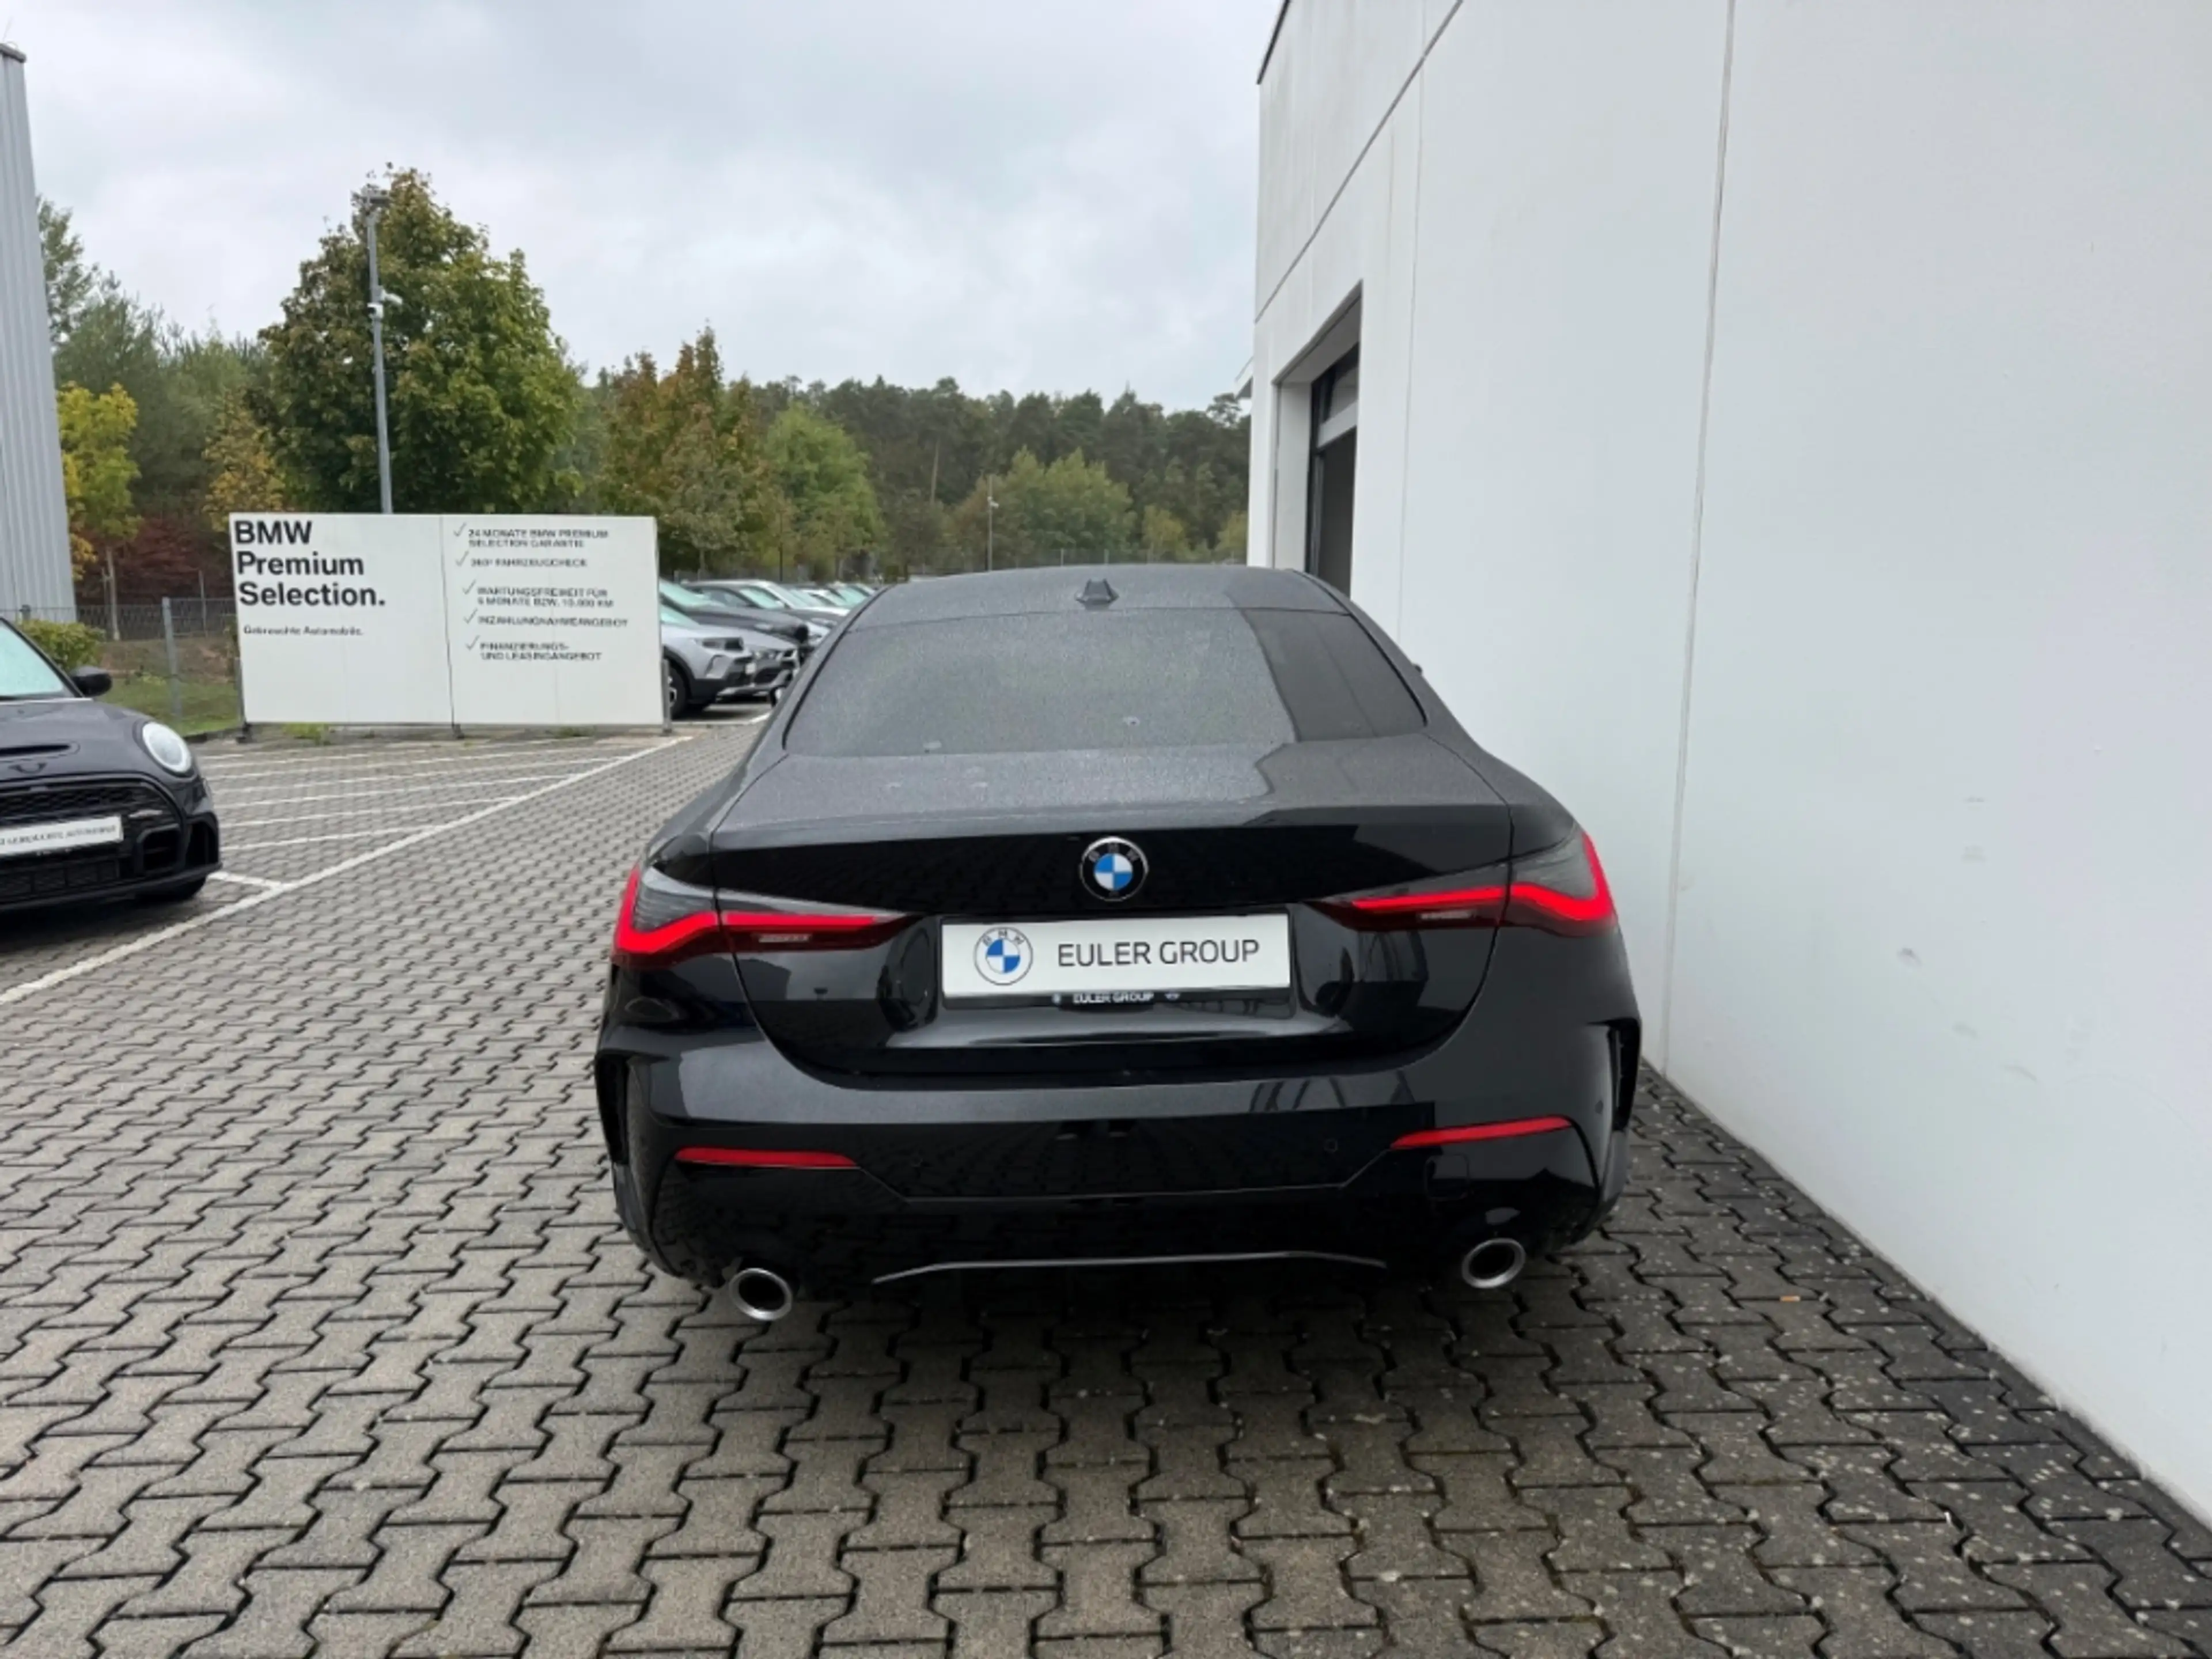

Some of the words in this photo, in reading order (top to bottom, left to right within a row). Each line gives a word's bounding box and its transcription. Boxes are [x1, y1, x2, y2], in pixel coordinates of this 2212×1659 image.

[234, 520, 312, 544] BMW
[237, 551, 364, 575] Premium
[239, 581, 385, 606] Selection.
[1058, 941, 1152, 967] EULER
[1159, 939, 1260, 964] GROUP
[1073, 993, 1111, 1004] EULER
[1112, 991, 1154, 1003] GROUP
